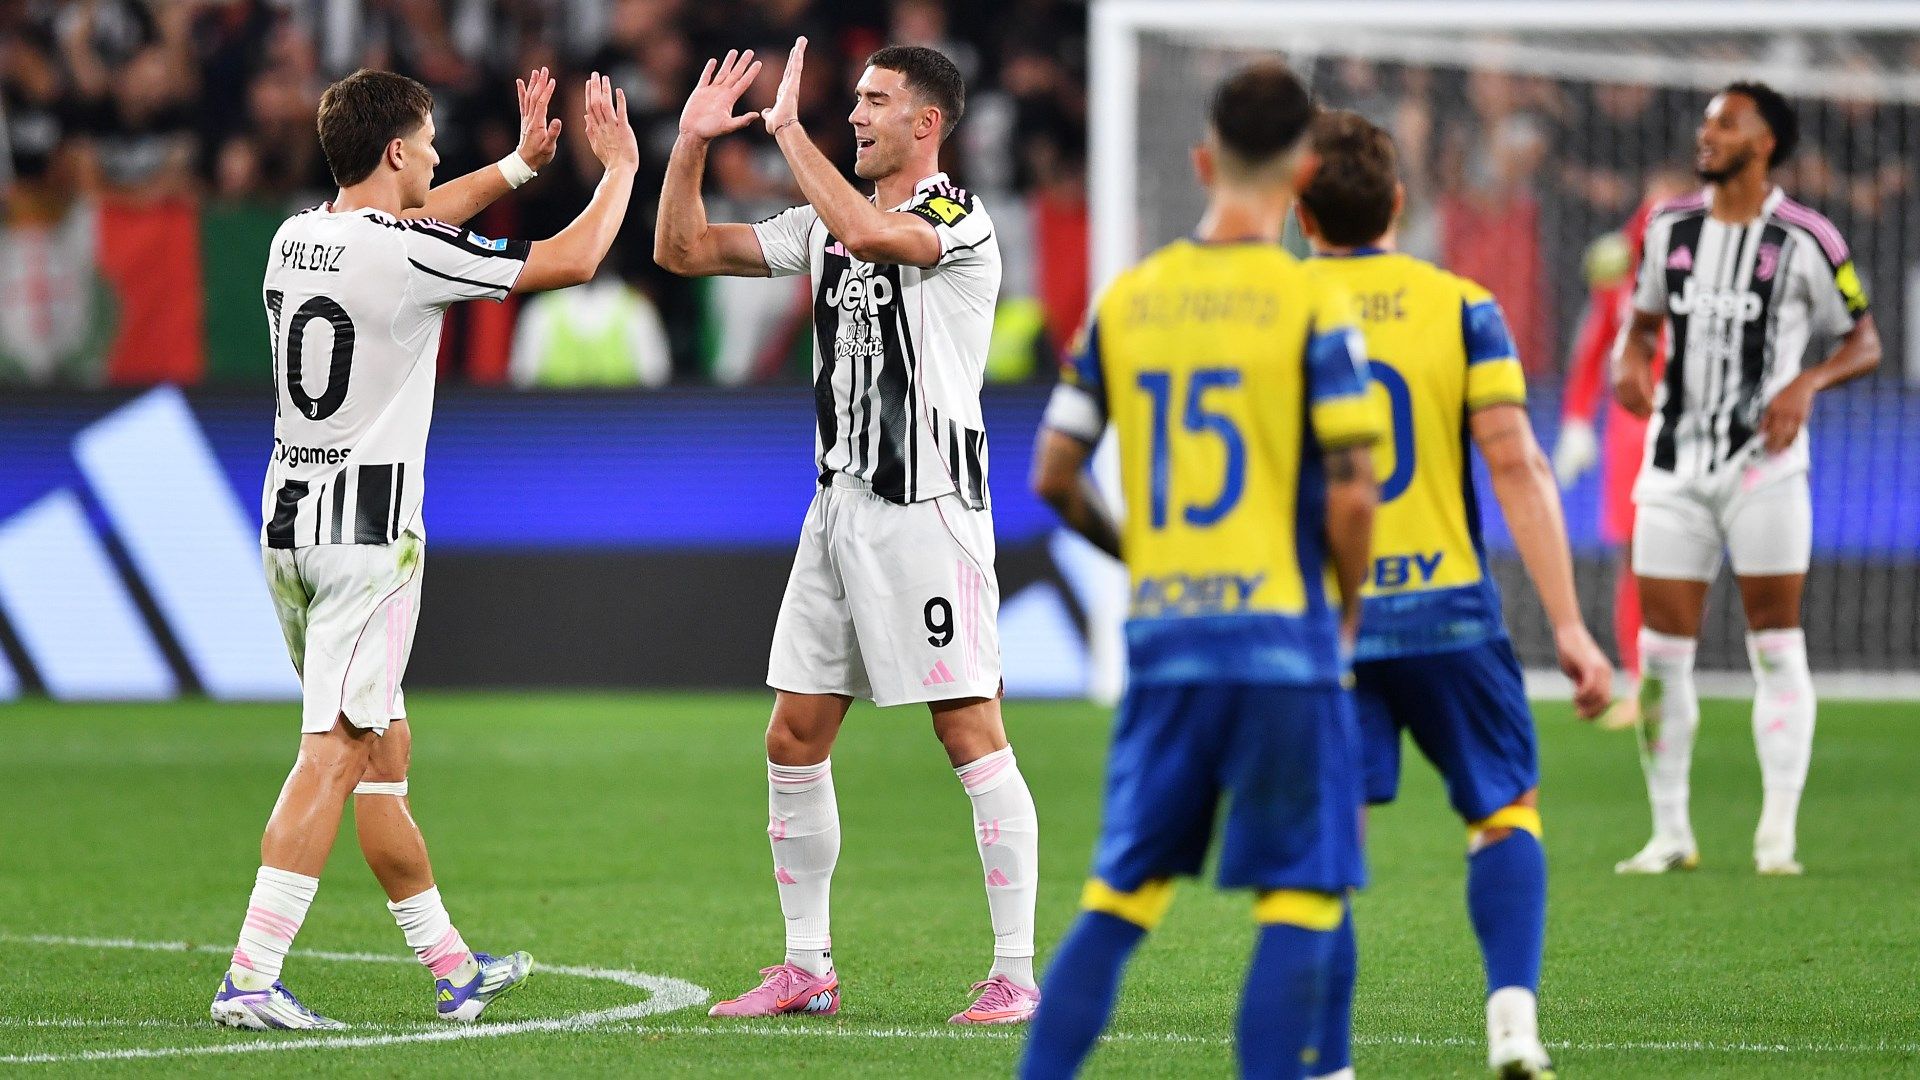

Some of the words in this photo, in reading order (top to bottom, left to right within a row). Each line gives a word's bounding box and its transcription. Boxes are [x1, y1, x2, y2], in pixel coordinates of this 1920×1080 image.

[281, 239, 346, 272] YILDIZ
[1136, 367, 1246, 530] 15
[924, 596, 954, 648] 9
